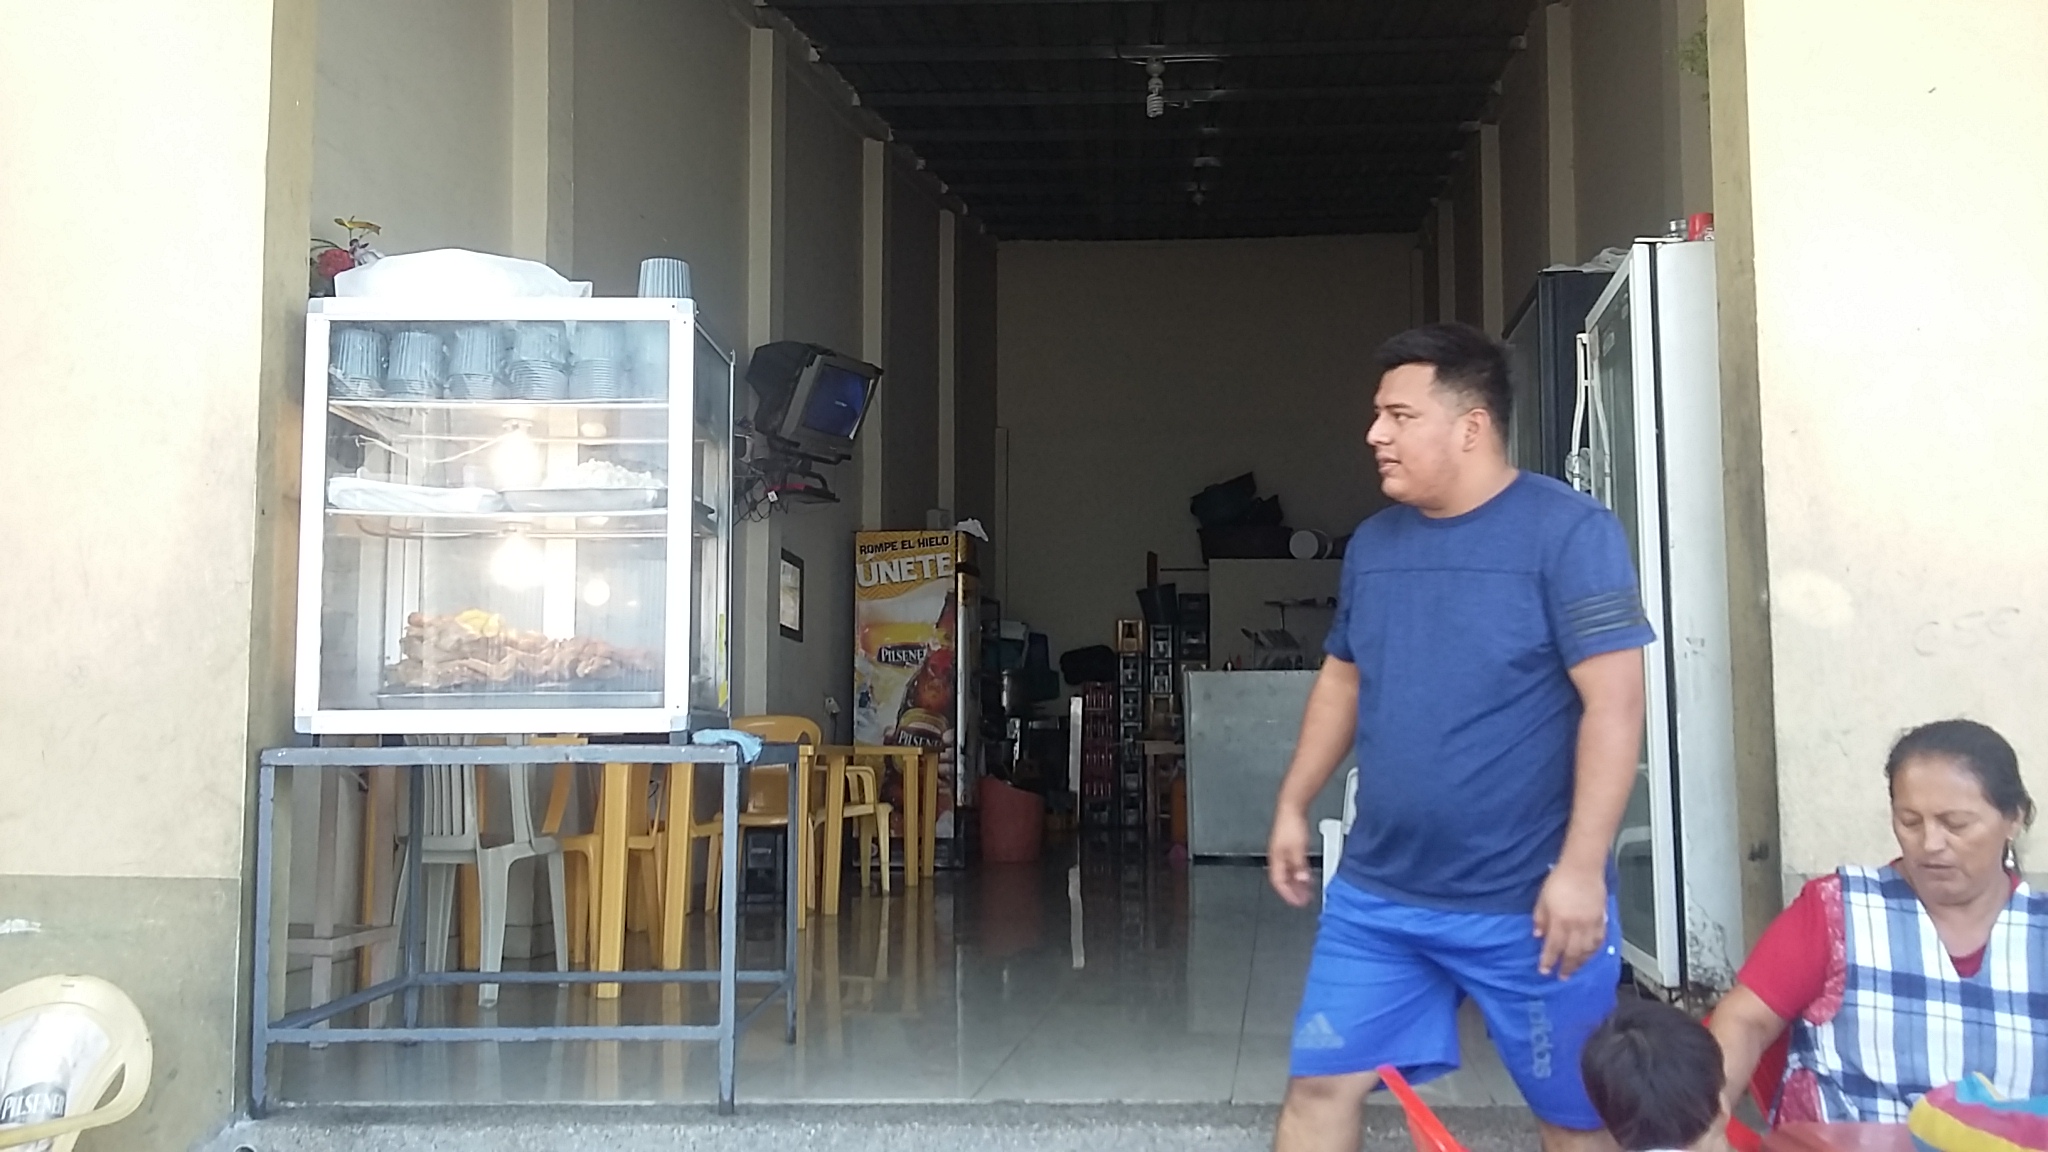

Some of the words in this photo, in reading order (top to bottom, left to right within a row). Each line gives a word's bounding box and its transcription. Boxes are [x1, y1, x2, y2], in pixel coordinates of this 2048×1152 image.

[859, 541, 899, 555] ROMPE
[901, 539, 916, 550] EL
[917, 535, 950, 549] HIELO
[856, 553, 955, 588] ÚNETE
[881, 647, 928, 662] PILSENE
